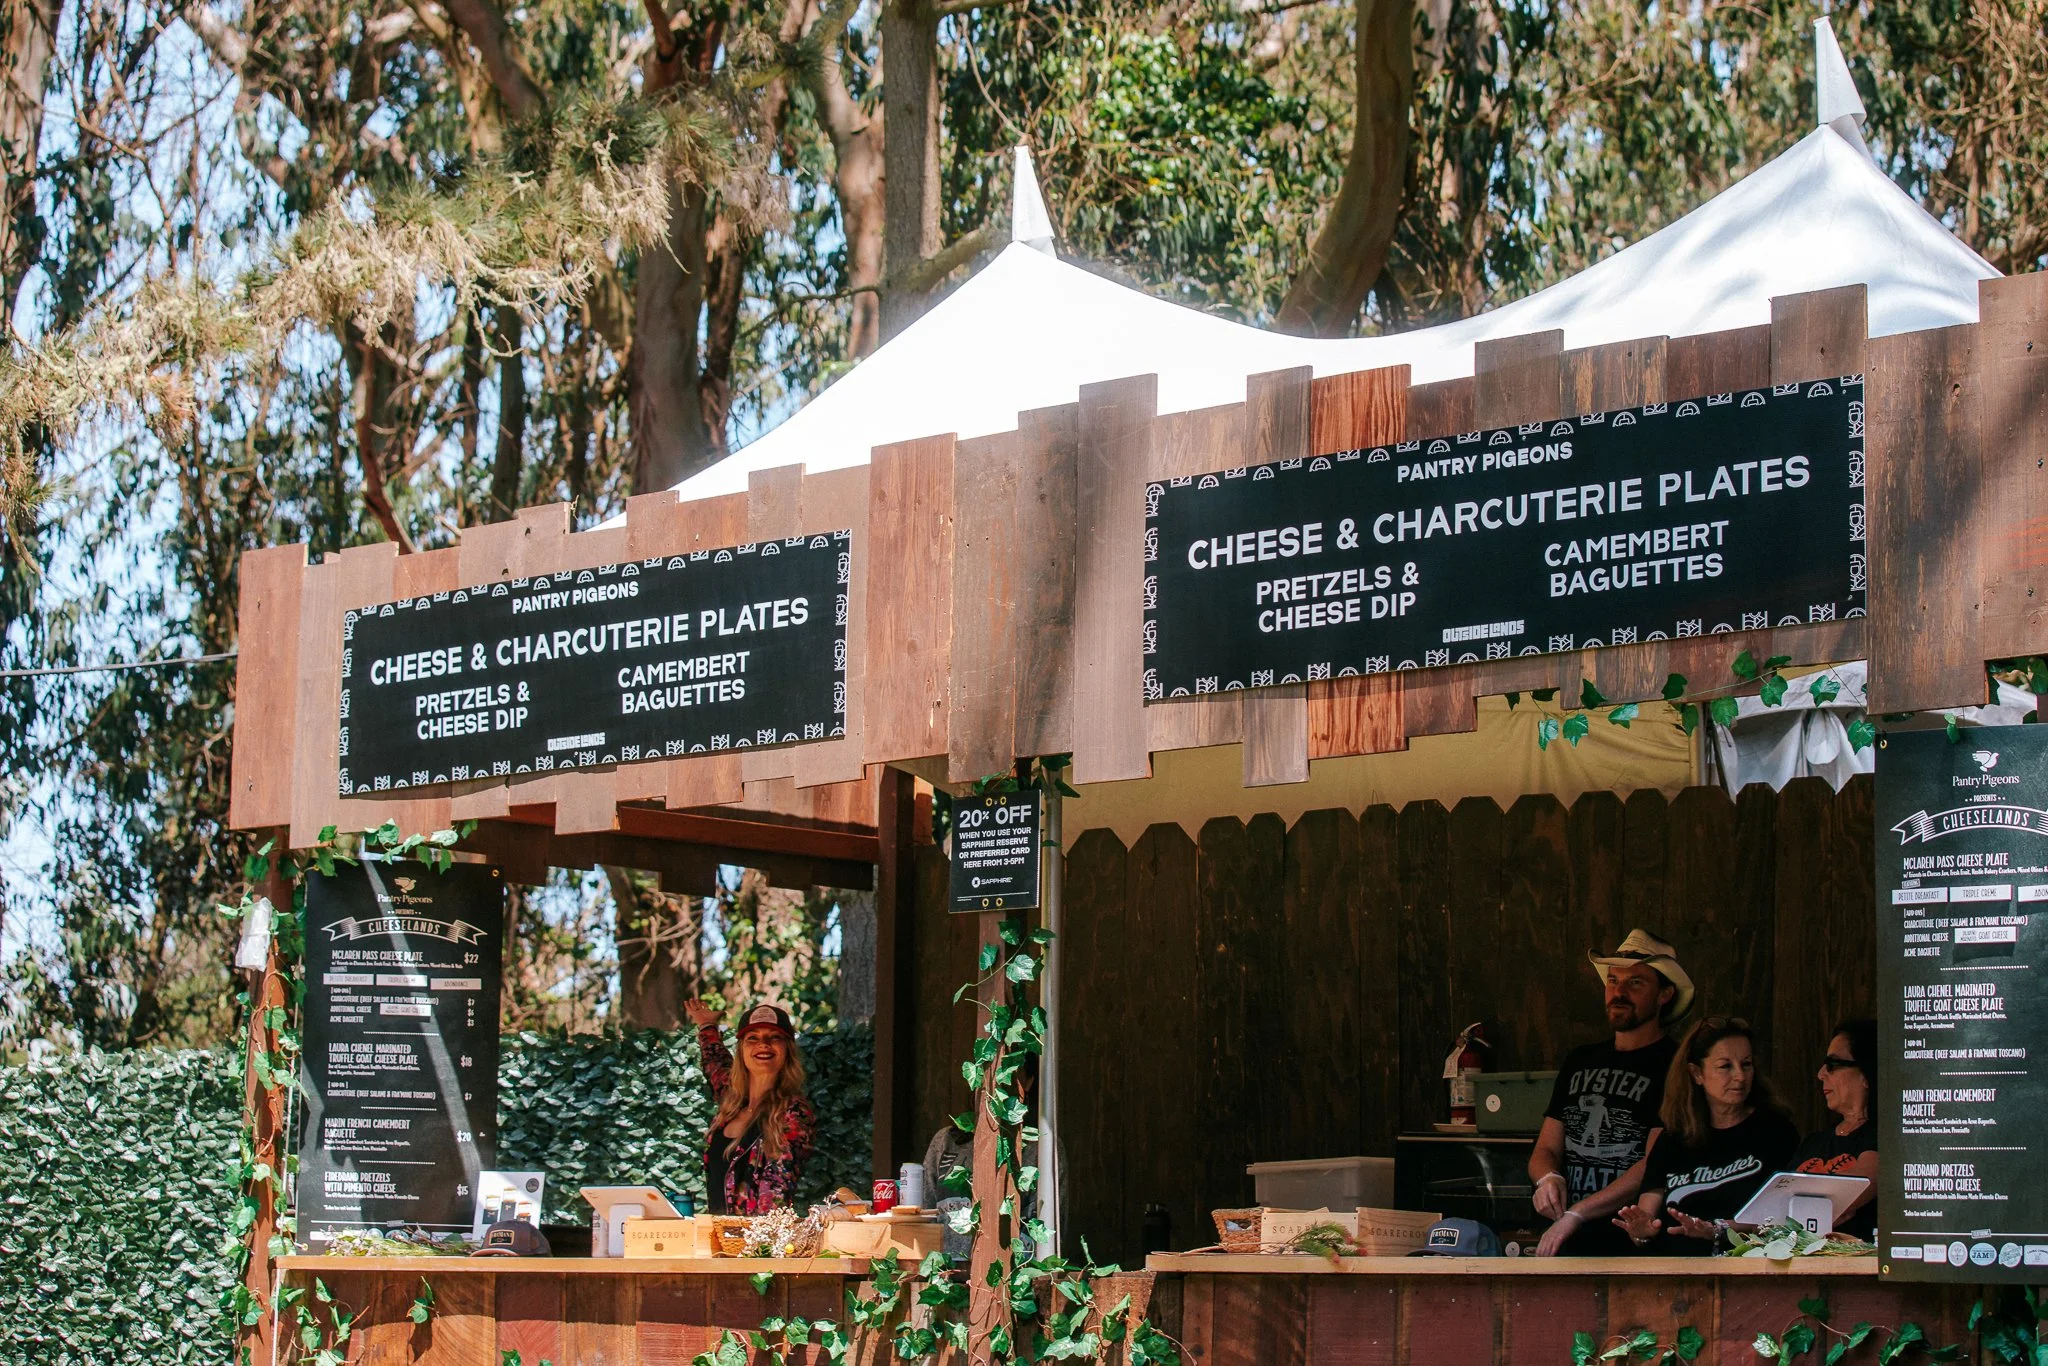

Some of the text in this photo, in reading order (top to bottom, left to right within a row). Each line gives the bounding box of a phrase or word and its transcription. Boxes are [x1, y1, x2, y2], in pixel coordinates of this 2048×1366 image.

[1397, 441, 1573, 483] PANTRY PIGEONS
[1187, 455, 1811, 571] CHEESE & CHARCUTERIE PLATES
[1543, 520, 1730, 568] CAMEMBERT
[1549, 553, 1724, 598] BAGUETTES
[1256, 562, 1420, 606] PRETZELS &
[512, 580, 639, 615] PANTRY PIGEONS
[1257, 591, 1417, 633] CHEESE DIP
[370, 597, 810, 687] CHEESE & CHARCUTERIE PLATES
[617, 651, 751, 690] CAMEMBERT
[416, 681, 531, 717] PRETZELS &
[621, 678, 746, 715] BAGUETTES
[417, 707, 529, 741] CHEESE DIP
[1952, 774, 2020, 788] Pantry Pigeons
[1973, 794, 1997, 802] PRESENTS
[959, 804, 1032, 828] 20% OFF
[1942, 809, 2030, 831] CHEESELANDS
[959, 827, 1032, 840] WHEN YOU USE YOUR
[961, 837, 1028, 849] SAPPHIRE RESERVE
[958, 846, 1031, 859] OR PREFERRED CARD
[963, 857, 1025, 869] HERE FROM 3-5PM
[1903, 852, 2009, 870] MCLAREN PASS CHEESE PLATE
[981, 877, 1011, 885] SAPPHIRE
[377, 893, 433, 905] Pantry Pigeons
[368, 920, 441, 935] CHEESELANDS
[1903, 919, 1934, 929] CHARCUTERIE
[1903, 932, 1949, 943] ADDITIONAL CHEESE
[332, 950, 479, 964] MCLAREN PASS CHEESE PLATE $22
[1903, 946, 1941, 957] ACME BAGUETTE
[1903, 982, 1996, 998] LAURA CHENEL MARINATED
[1904, 997, 2004, 1013] TRUFFLE GOAT CHEESE PLATE
[328, 1042, 412, 1054] LAURA CHENEL MARINATED
[1903, 1049, 1934, 1059] CHARCUTERIE
[328, 1053, 473, 1067] TRUFFLE GOAT CHEESE PLATE $18
[1568, 1067, 1651, 1102] OYSTER
[1902, 1088, 1997, 1102] MARIN FRENCH CAMEMBERT
[1903, 1103, 1936, 1117] BAGUETTE
[325, 1117, 411, 1129] MARIN FRENCH CAMEMBERT
[325, 1128, 472, 1143] BAGUETTE $20
[1693, 1154, 1755, 1183] Theater
[1904, 1163, 1974, 1177] FIREBRAND PRETZELS
[325, 1171, 391, 1183] FIREBRAND PRETZELS
[324, 1181, 469, 1196] WITH PIMENTO CHEESE $15
[1904, 1178, 1981, 1192] WITH PIMENTO CHEESE
[632, 1231, 688, 1239] SCARECROW
